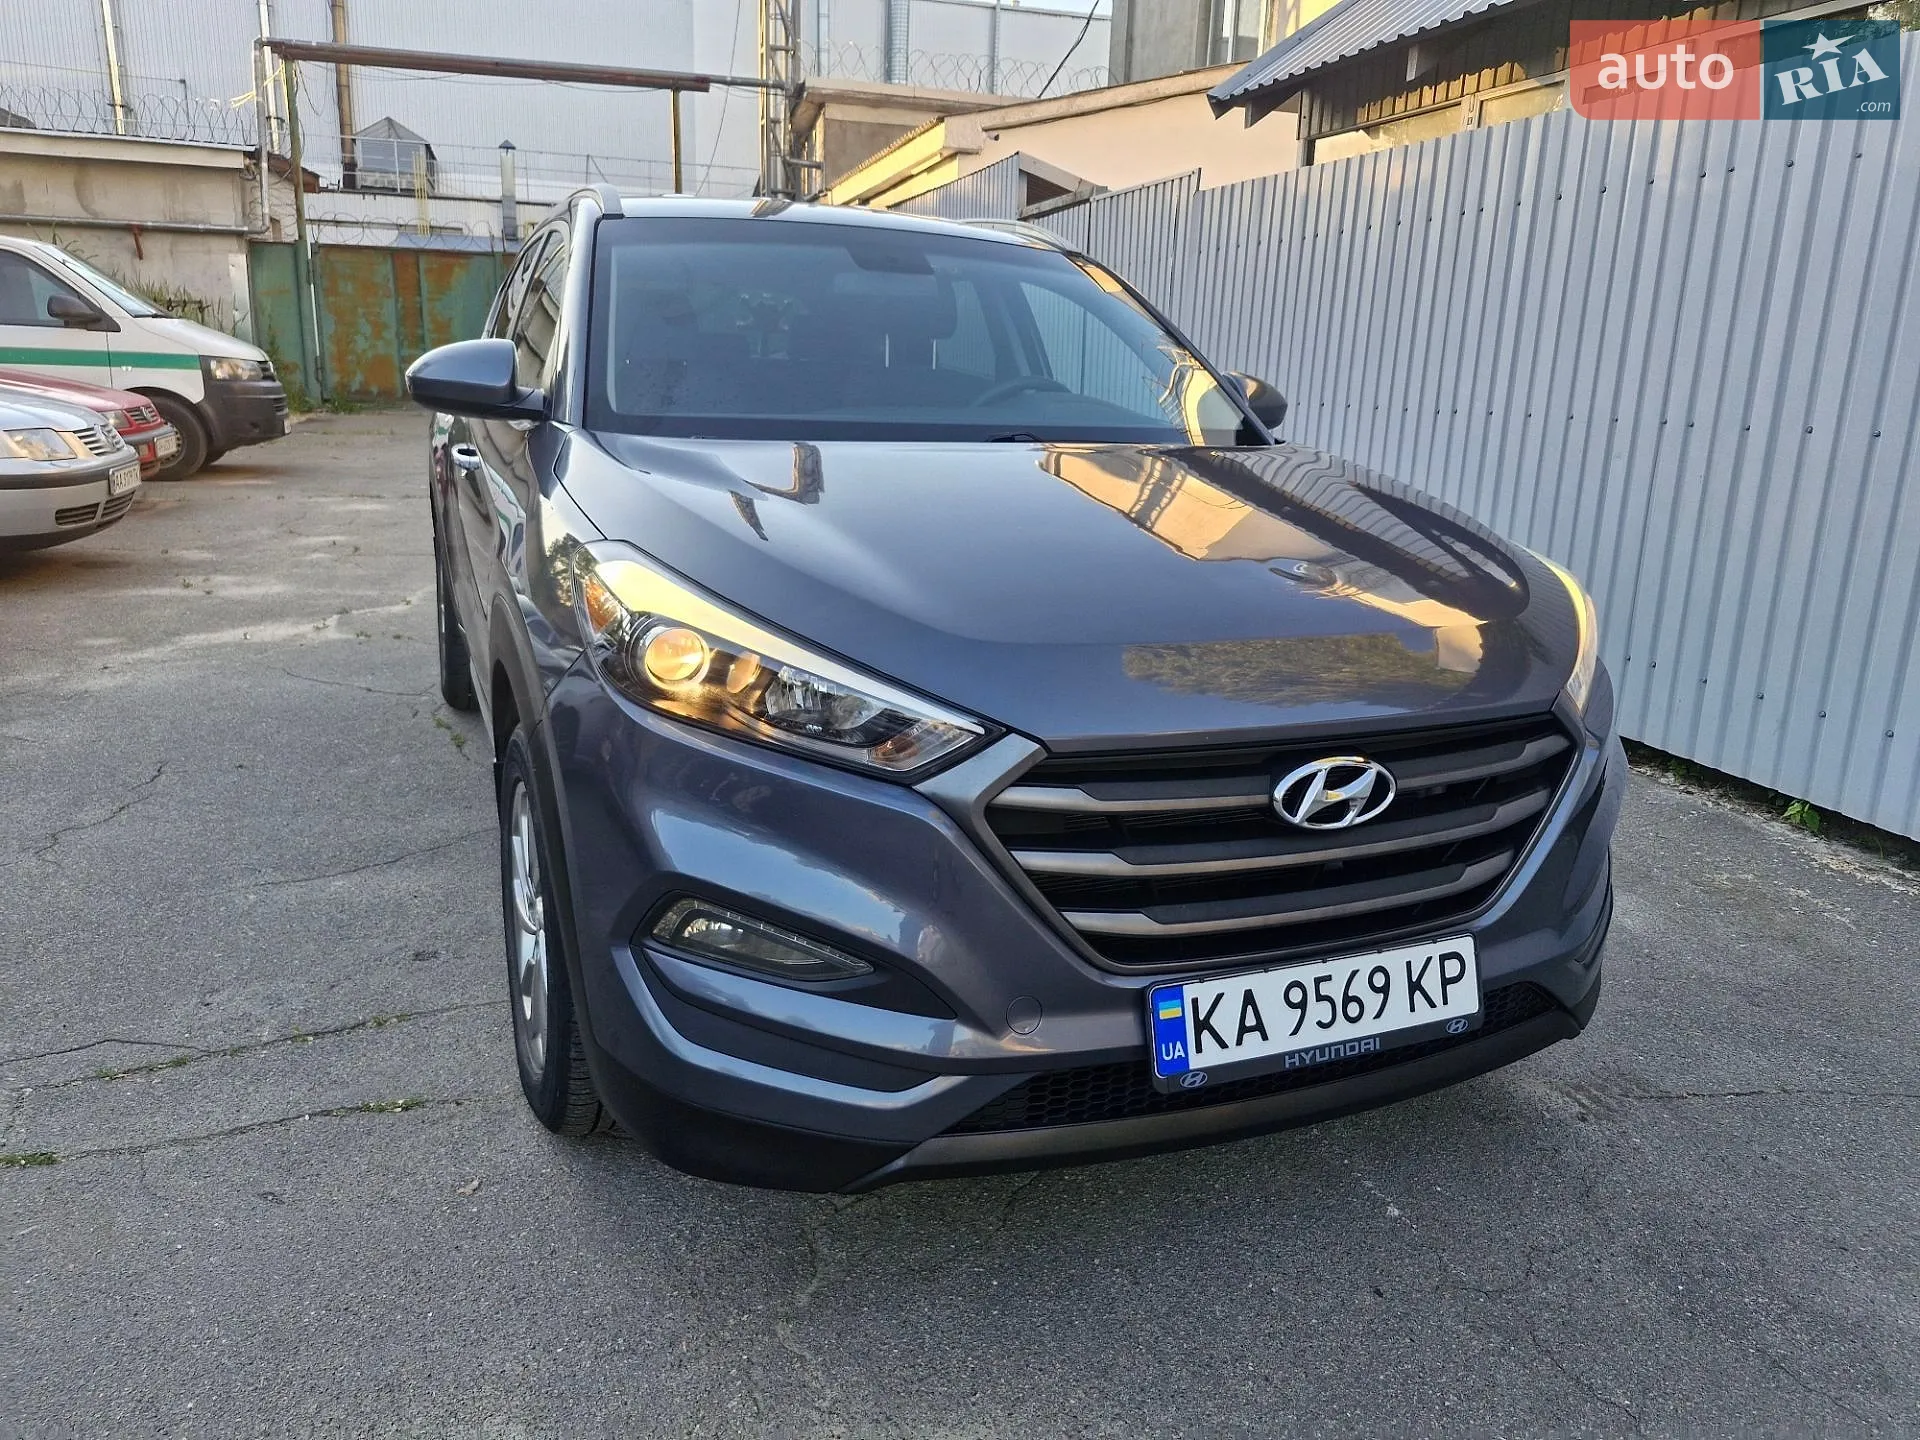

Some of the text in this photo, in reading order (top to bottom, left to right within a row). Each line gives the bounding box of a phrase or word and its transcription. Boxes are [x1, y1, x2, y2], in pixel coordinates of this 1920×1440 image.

[1191, 951, 1467, 1054] KA 9569 KP
[1162, 1041, 1186, 1061] UA
[1284, 1038, 1380, 1069] HYUNDAI
